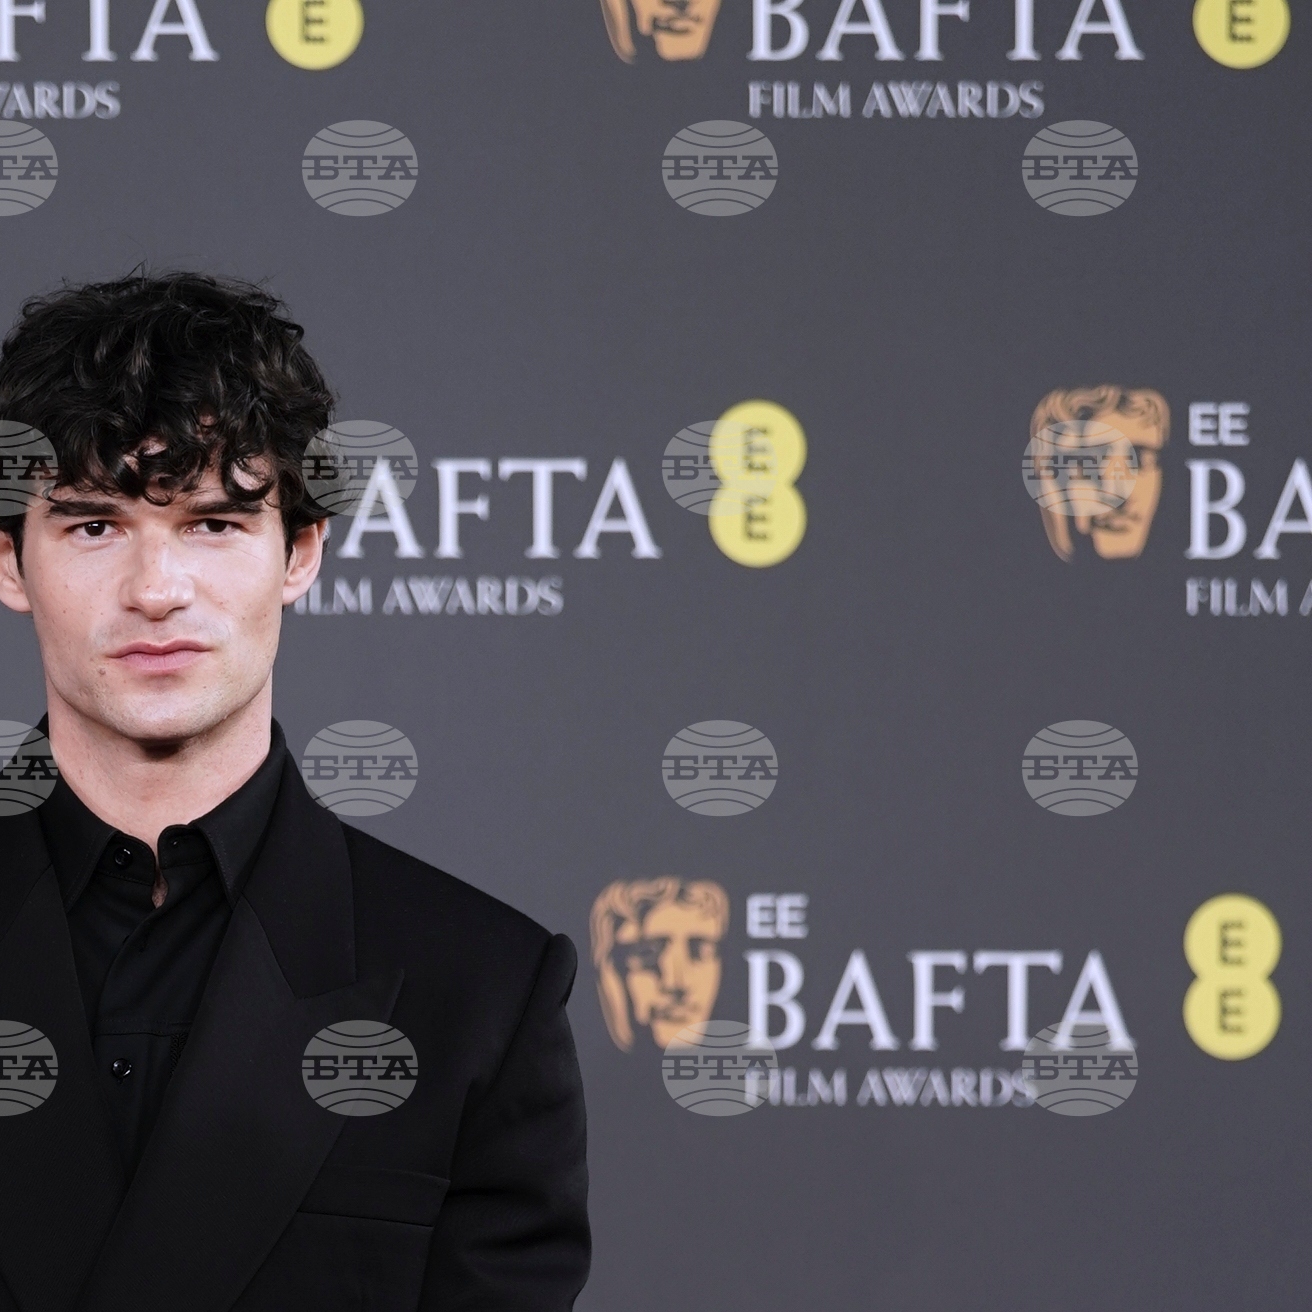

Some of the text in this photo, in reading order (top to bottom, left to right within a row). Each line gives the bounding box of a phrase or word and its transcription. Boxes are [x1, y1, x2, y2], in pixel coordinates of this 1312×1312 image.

[748, 80, 1045, 119] FILM AWARDS
[1188, 402, 1250, 446] EE
[383, 575, 565, 616] AWARDS
[1186, 576, 1288, 616] FILM
[746, 894, 808, 938] EE
[745, 949, 1135, 1052] BAFTA
[744, 1067, 1039, 1107] FILM AWARDS
